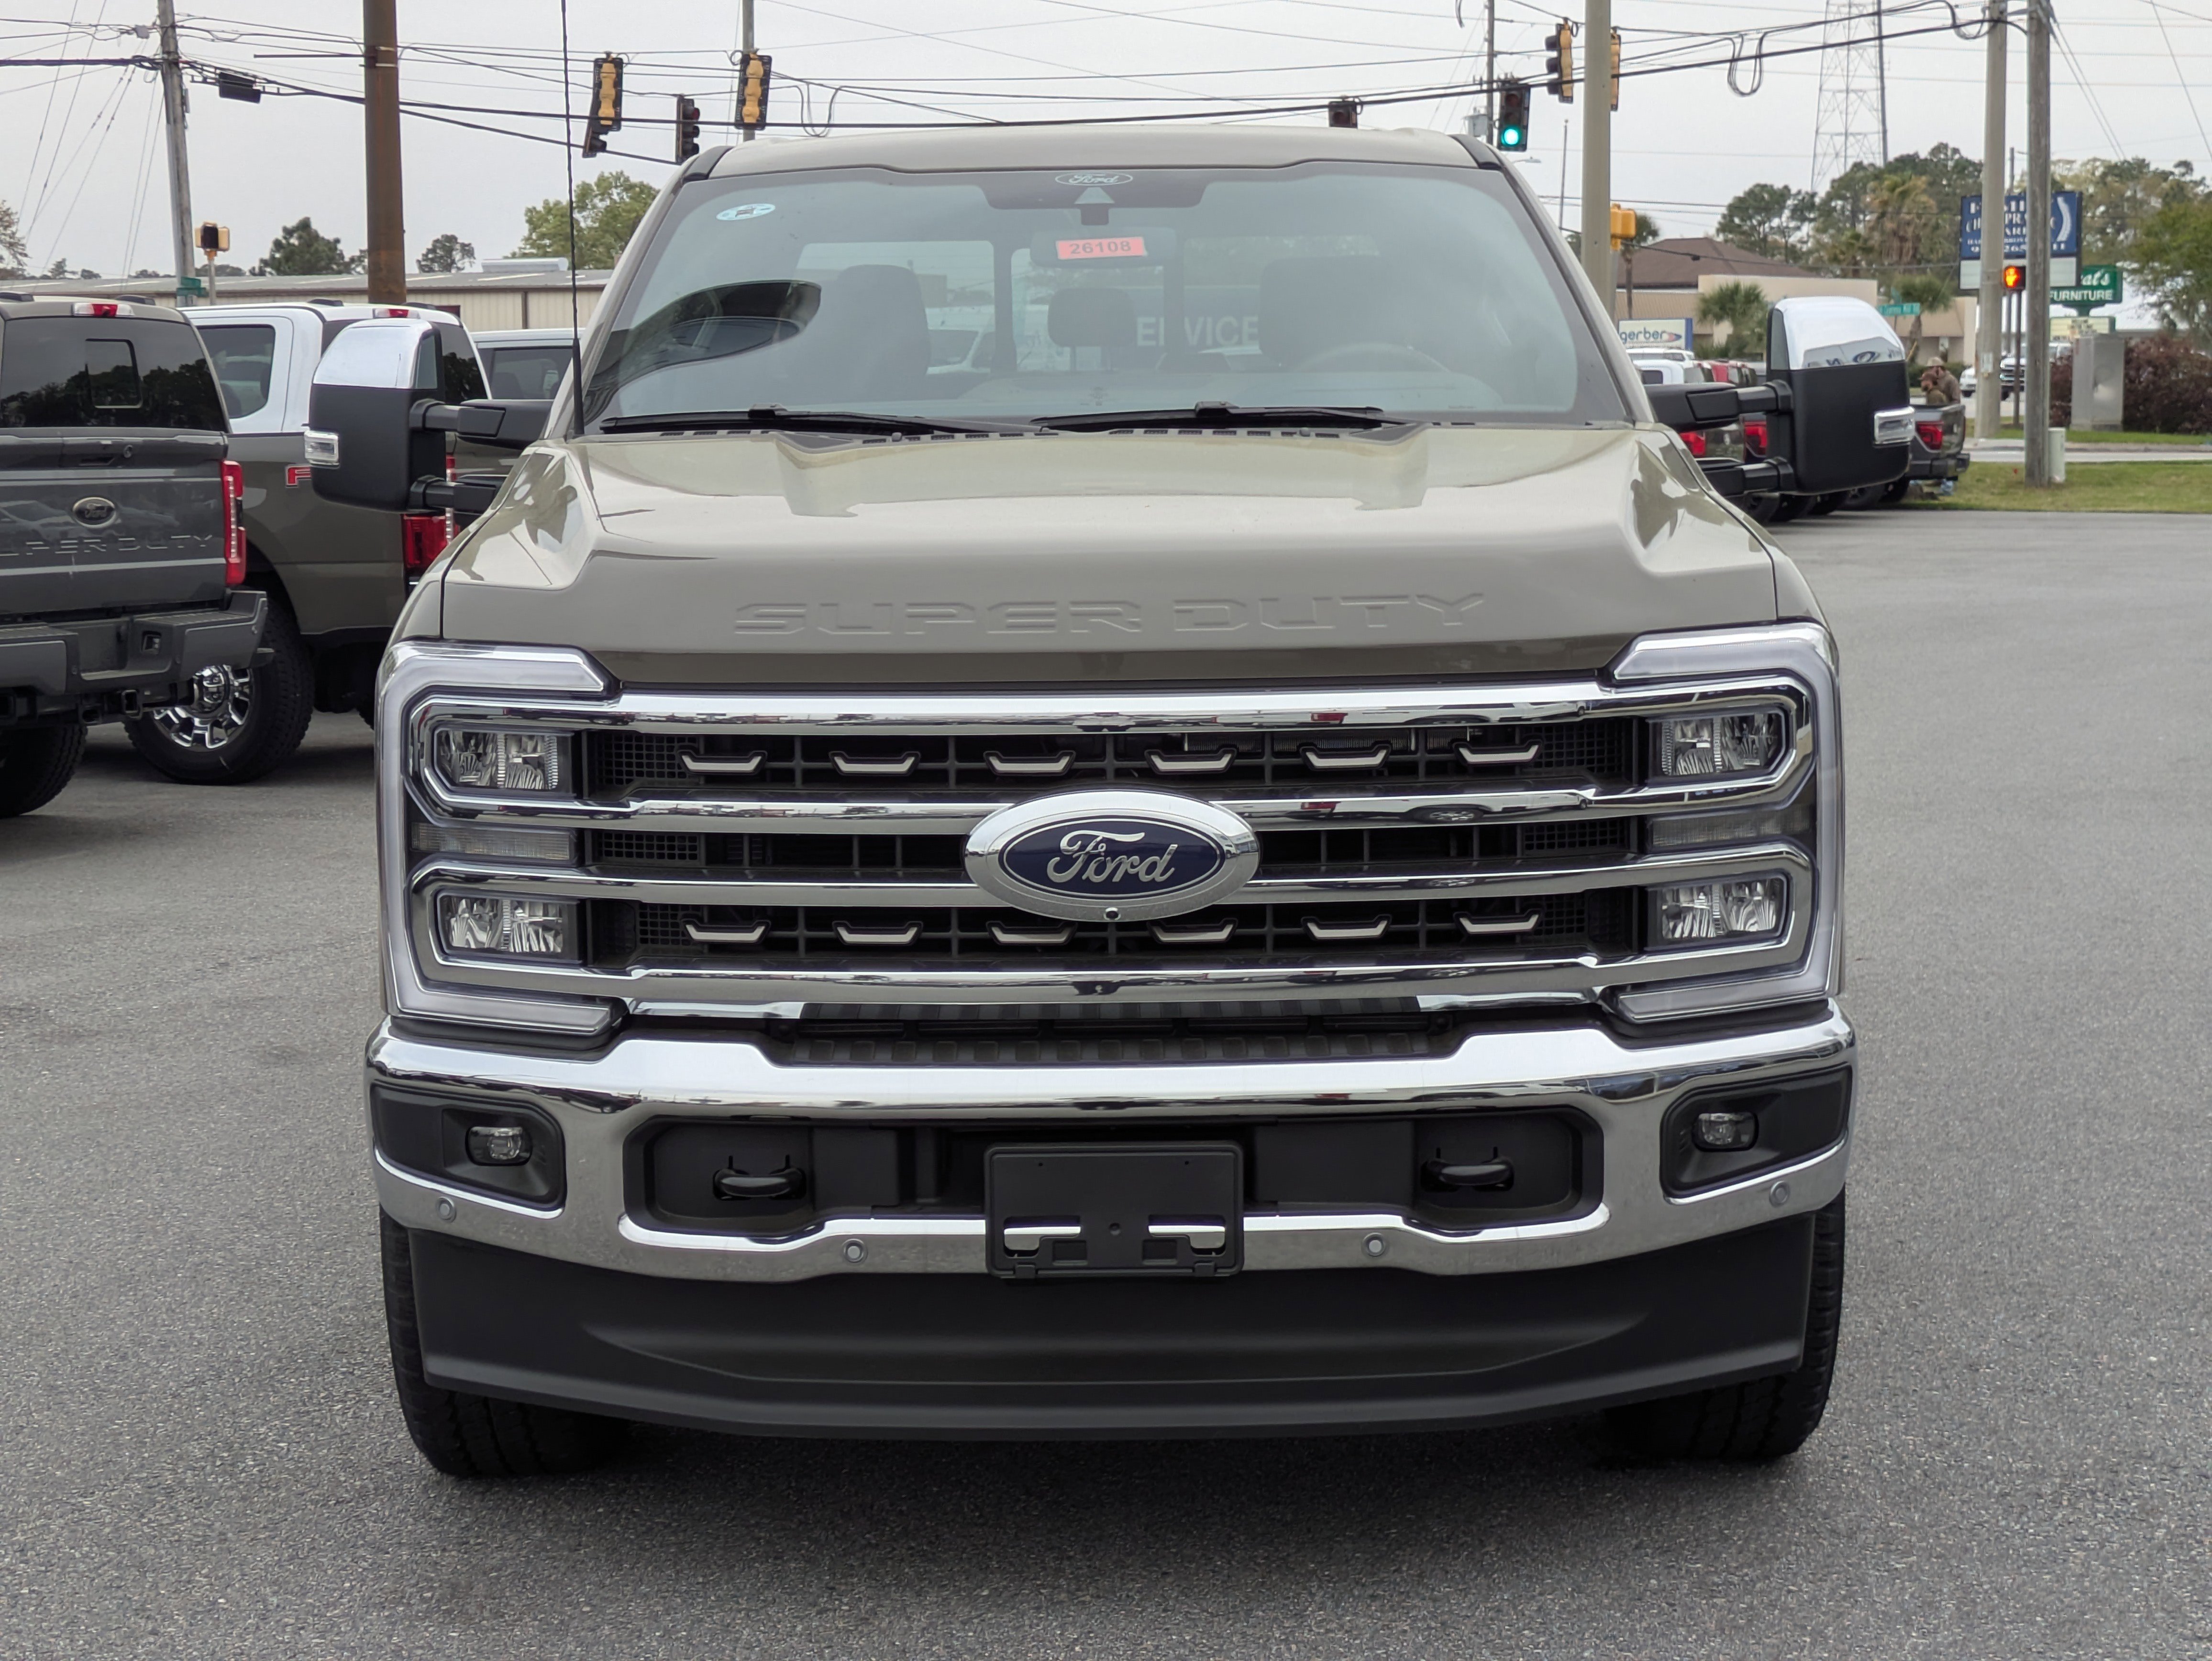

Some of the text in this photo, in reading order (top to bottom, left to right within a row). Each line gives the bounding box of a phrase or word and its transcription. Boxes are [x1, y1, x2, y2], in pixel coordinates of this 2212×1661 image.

[1069, 173, 1119, 183] Ford
[1069, 240, 1132, 255] 26108
[1619, 326, 1666, 345] gerber
[734, 593, 1484, 634] SUPER DUTY
[1047, 830, 1179, 884] Ford
